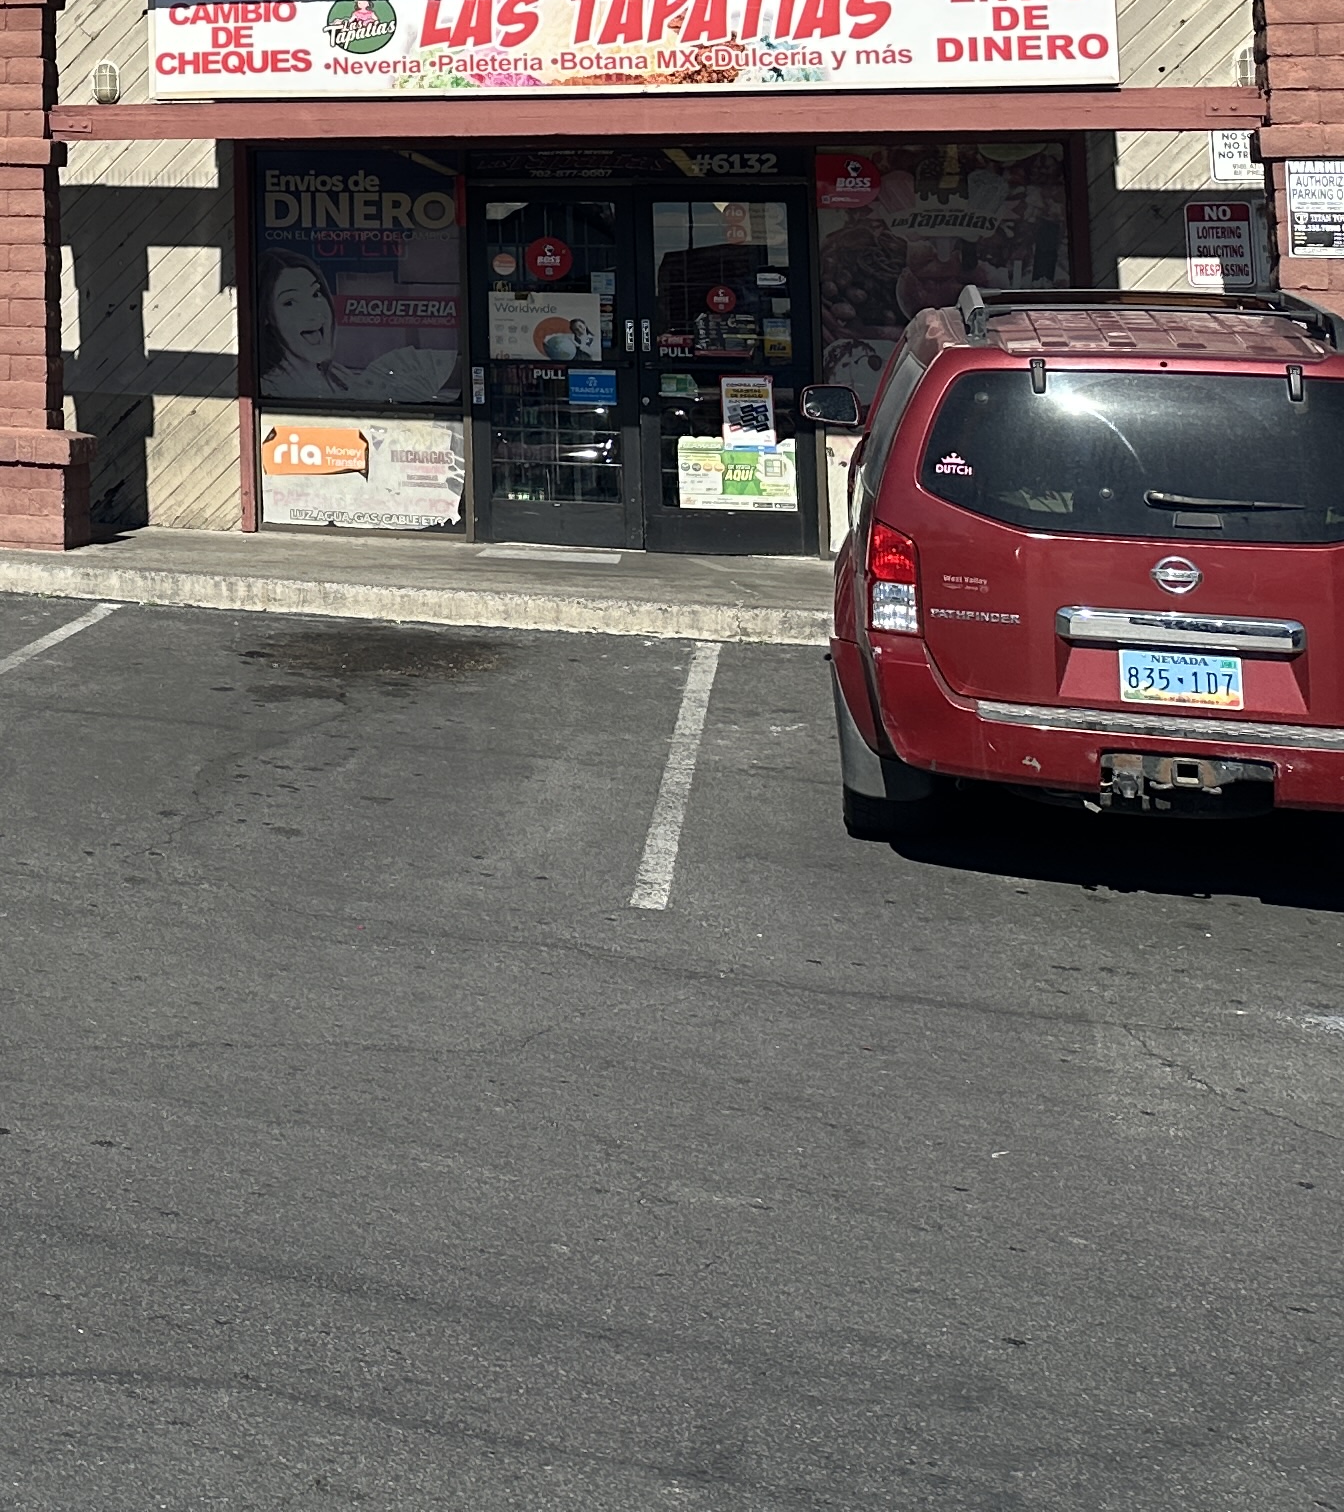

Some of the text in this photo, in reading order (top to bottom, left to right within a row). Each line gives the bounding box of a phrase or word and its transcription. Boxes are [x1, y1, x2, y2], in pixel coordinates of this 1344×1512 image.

[169, 0, 297, 27] CAMBIO
[992, 5, 1050, 31] DE
[342, 20, 362, 31] Las
[211, 26, 253, 49] DE
[323, 21, 395, 49] Tapatias
[936, 33, 1109, 63] DINERO
[155, 49, 312, 75] CHEQUES
[657, 48, 696, 68] MX
[831, 50, 846, 70] y
[855, 44, 912, 64] más
[1222, 132, 1237, 140] NO
[1218, 151, 1234, 159] NO
[691, 153, 778, 174] #6132
[1288, 161, 1344, 173] WARNI
[265, 170, 380, 192] Envios de
[836, 177, 871, 187] BOSS
[1292, 189, 1333, 200] PARKING
[264, 192, 456, 230] DINERO
[725, 208, 744, 218] ria
[1204, 206, 1231, 220] NO
[891, 212, 996, 230] Las Tapatias
[265, 231, 293, 241] CON
[295, 231, 310, 241] EL
[726, 229, 744, 238] ria
[1197, 226, 1241, 239] LOITERING
[1197, 245, 1244, 258] SOLICITING
[1194, 264, 1249, 277] TRESPASSING
[345, 299, 457, 316] PAQUETERIA
[495, 303, 557, 313] Worldwide
[660, 347, 693, 357] PULL
[534, 369, 565, 379] PULL
[273, 433, 322, 465] ria
[326, 446, 362, 457] Money
[391, 450, 453, 465] RECARGAS
[725, 467, 753, 481] AQUÍ
[936, 464, 973, 475] DUTCH
[382, 514, 419, 526] CABLE
[943, 575, 988, 586] West Valley
[930, 608, 1021, 624] PATHFINDER
[1150, 655, 1210, 666] NEVADA
